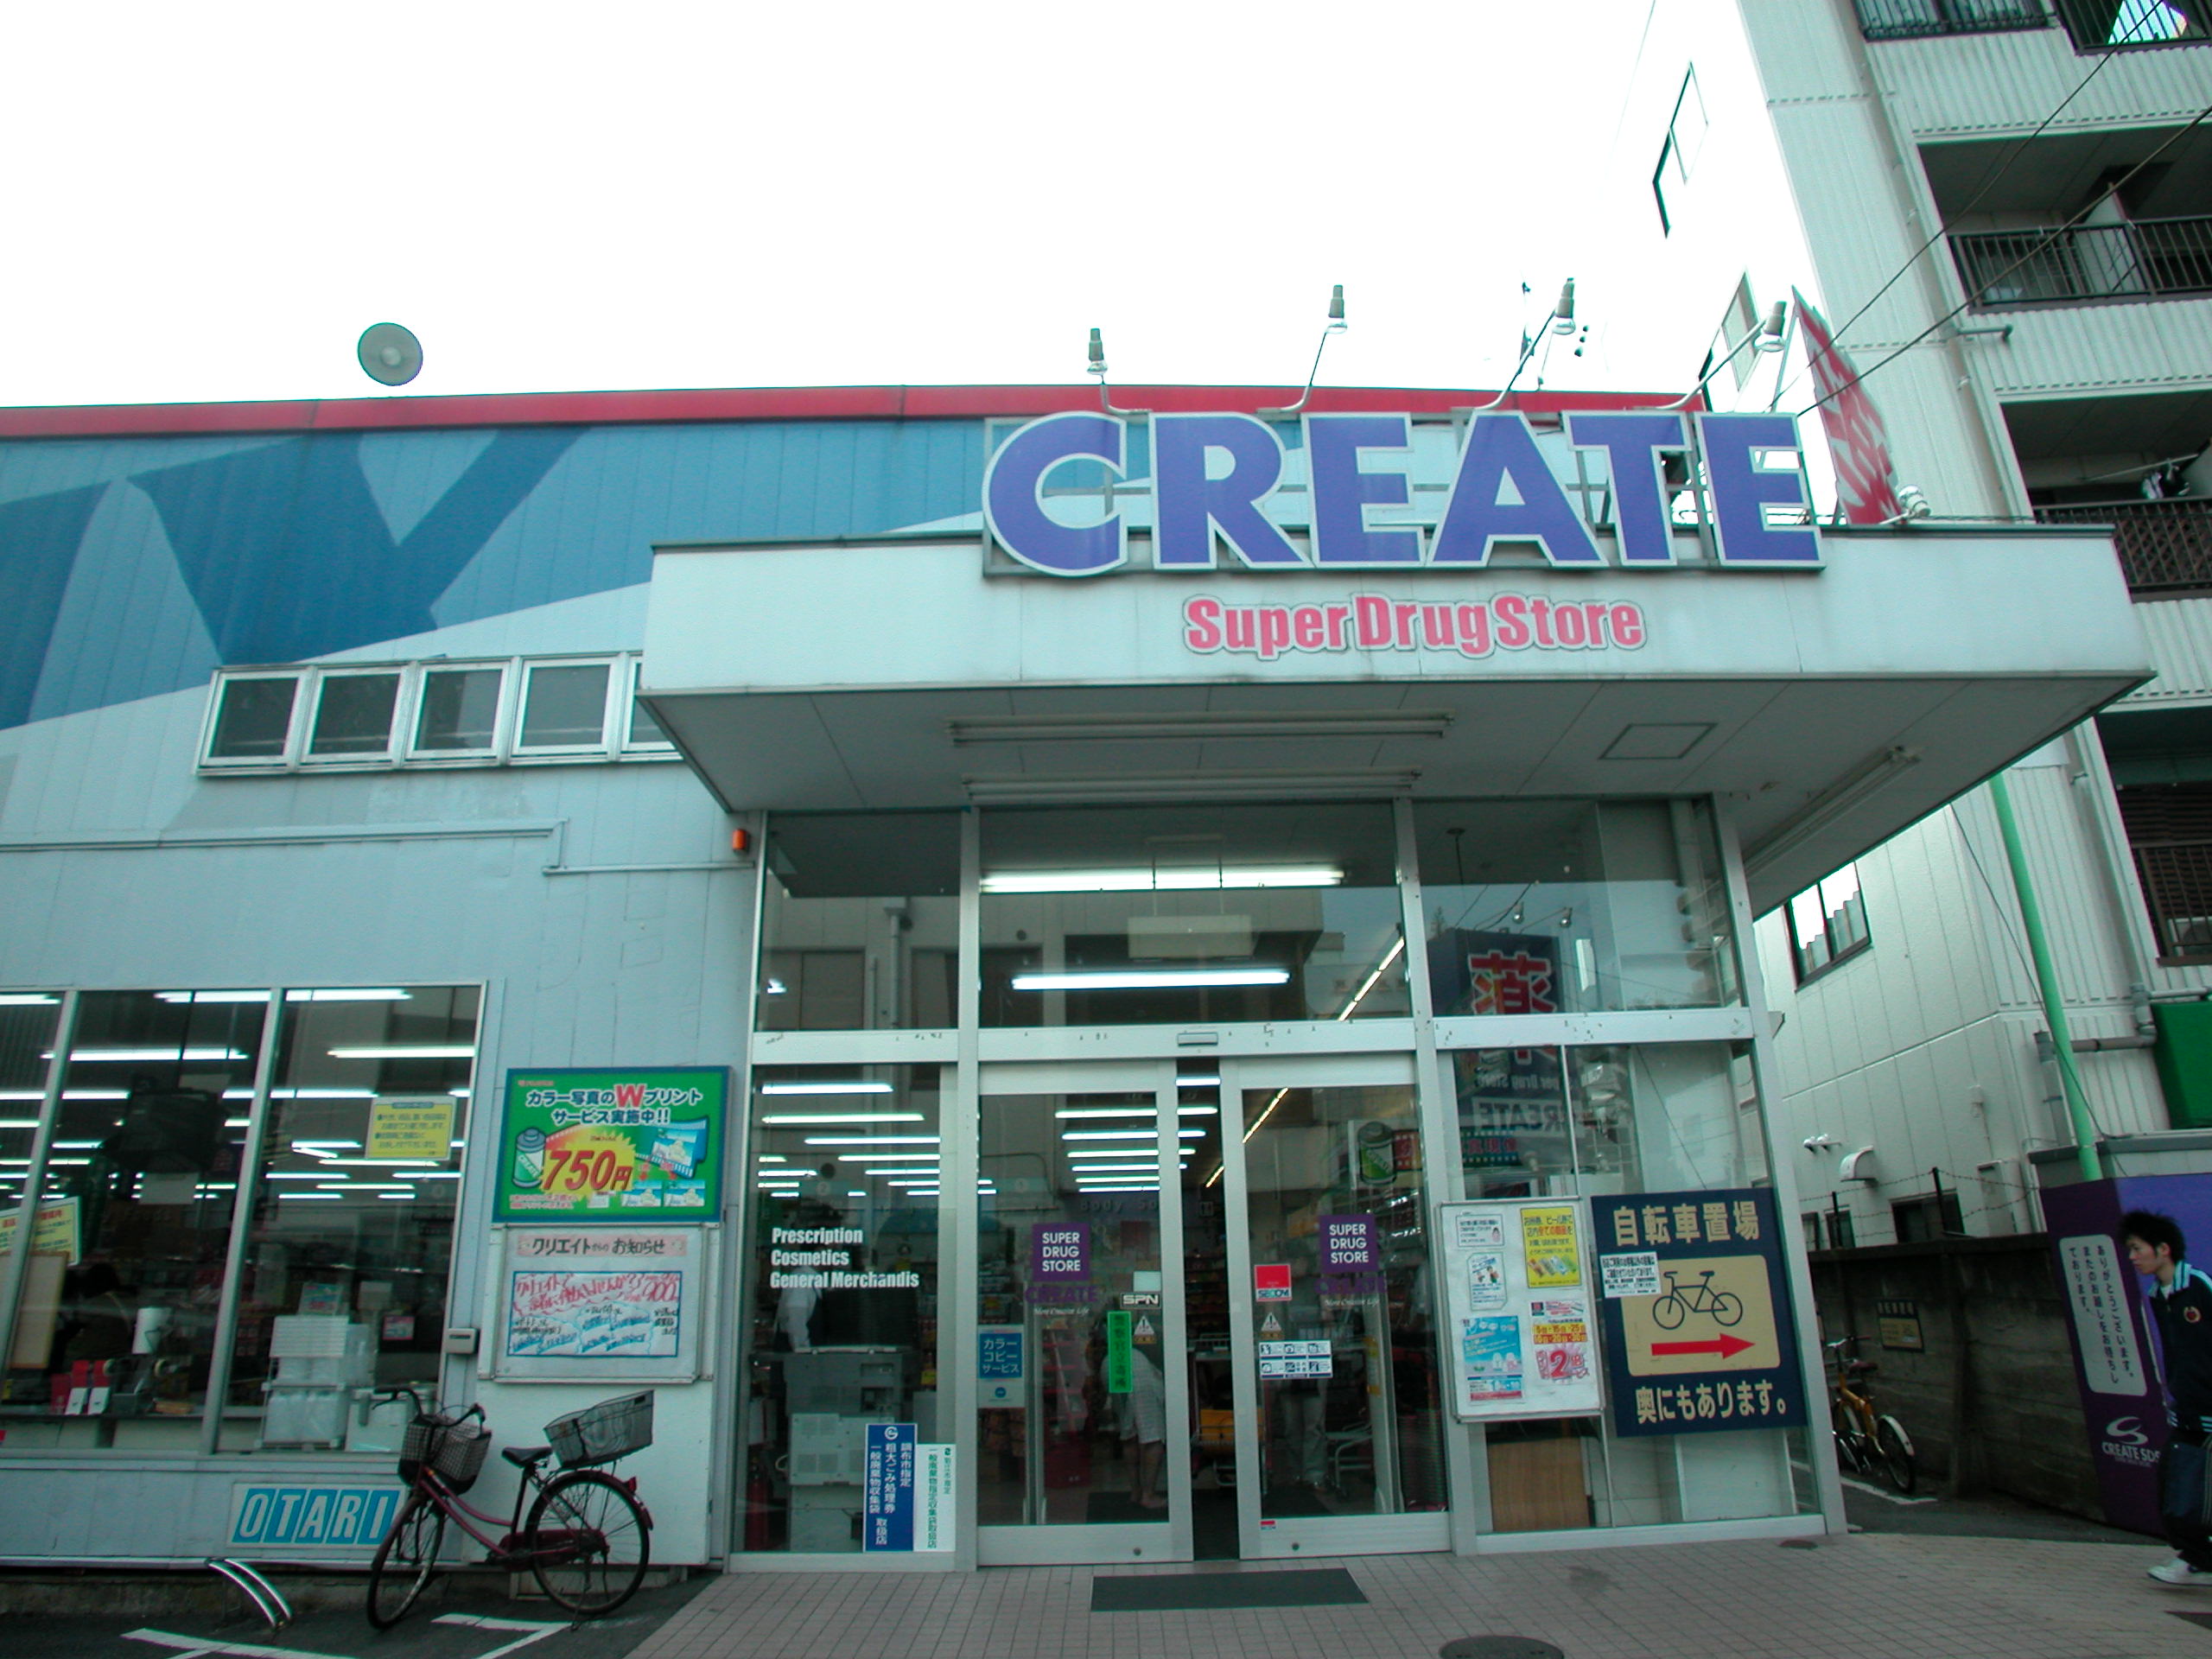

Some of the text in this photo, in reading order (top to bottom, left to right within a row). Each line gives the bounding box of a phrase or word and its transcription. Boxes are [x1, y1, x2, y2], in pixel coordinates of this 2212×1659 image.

[983, 411, 1824, 575] CREATE
[525, 1084, 702, 1108] カラー写真のWプリント
[542, 1149, 634, 1191] 750円
[1329, 1224, 1366, 1236] SUPER
[1613, 1200, 1761, 1247] 自転車置場
[772, 1227, 863, 1245] Prescription
[1042, 1232, 1080, 1244] SUPER
[1330, 1237, 1367, 1249] DRUG
[771, 1249, 849, 1267] Cosmetics
[1042, 1246, 1080, 1258] DRUG
[1331, 1251, 1369, 1263] STORE
[1042, 1260, 1081, 1272] STORE
[770, 1271, 919, 1288] General Merchandis
[1122, 1294, 1159, 1305] SPN
[983, 1339, 1017, 1349] カラー
[983, 1351, 1017, 1363] コピー
[982, 1363, 1020, 1374] サービス
[1635, 1379, 1787, 1425] 奥にもあります。
[2101, 1440, 2140, 1460] CREATE
[899, 1442, 912, 1488] 調布市指定
[884, 1442, 897, 1514] 粗大ごみ処理券
[238, 1493, 390, 1539] OTARI
